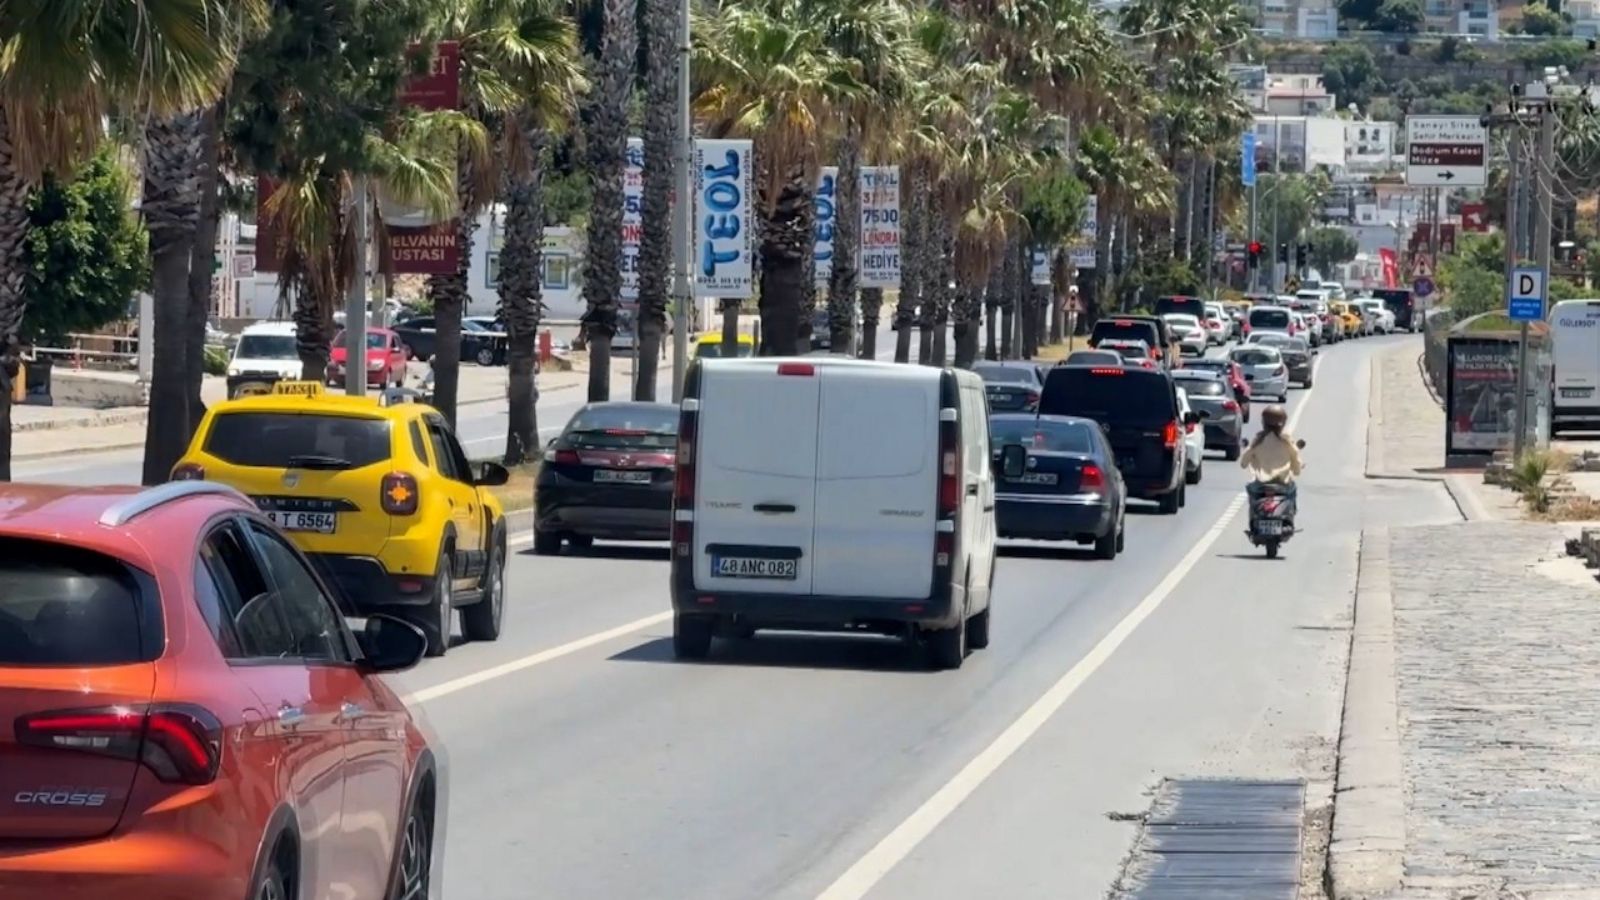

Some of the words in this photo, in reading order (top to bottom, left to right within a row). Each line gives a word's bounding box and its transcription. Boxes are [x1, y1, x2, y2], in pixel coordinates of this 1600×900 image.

[1412, 146, 1451, 155] Bodrum
[1452, 147, 1481, 155] Kalesi
[703, 149, 741, 277] TEOL
[863, 209, 898, 223] 7500
[391, 249, 445, 261] USTASI
[863, 250, 899, 268] HEDİYE
[1520, 274, 1535, 295] D
[260, 498, 333, 507] USTER
[282, 513, 293, 527] T
[297, 513, 333, 528] 6564
[720, 559, 738, 573] 48
[739, 559, 766, 574] ANC
[767, 561, 794, 575] 082
[14, 791, 106, 806] CROSS
